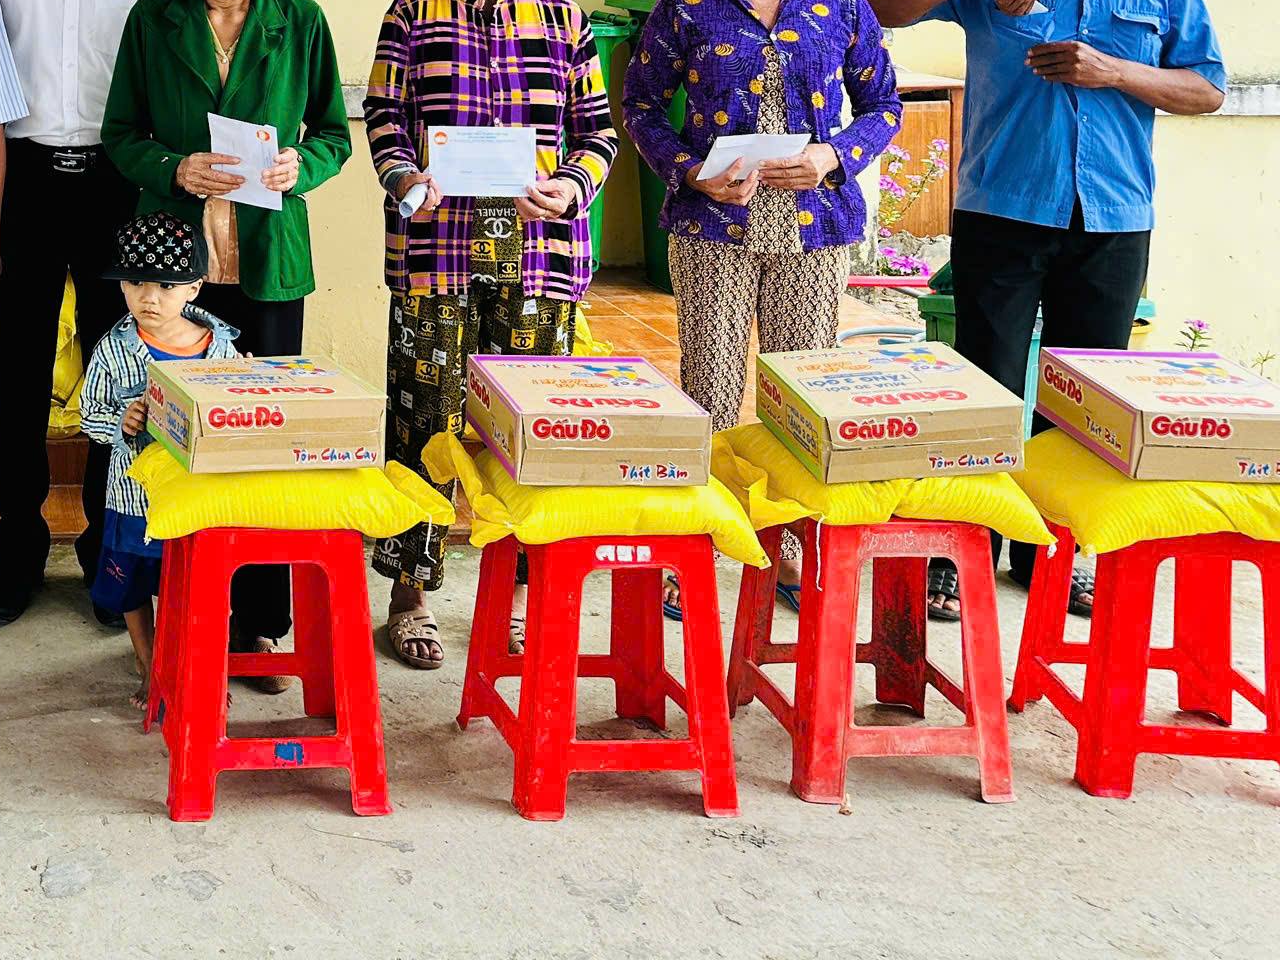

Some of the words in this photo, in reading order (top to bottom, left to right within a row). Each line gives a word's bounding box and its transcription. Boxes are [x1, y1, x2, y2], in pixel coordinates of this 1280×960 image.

[476, 207, 517, 217] CHANEL
[208, 406, 252, 429] Gấu
[254, 405, 285, 427] Đỏ
[532, 418, 578, 440] Gấu
[580, 418, 611, 440] Đỏ
[839, 419, 884, 440] Gấu
[886, 416, 919, 438] Đỏ
[1151, 416, 1198, 437] Gấu
[1199, 417, 1231, 439] Đỏ
[293, 448, 317, 462] Tôm
[320, 447, 350, 462] Chua
[355, 447, 377, 461] Cay
[929, 456, 954, 469] Tôm
[958, 455, 990, 467] Chua
[994, 452, 1017, 466] Cay
[619, 464, 651, 481] Thịt
[656, 462, 688, 478] Bằm
[1238, 461, 1270, 476] Thịt
